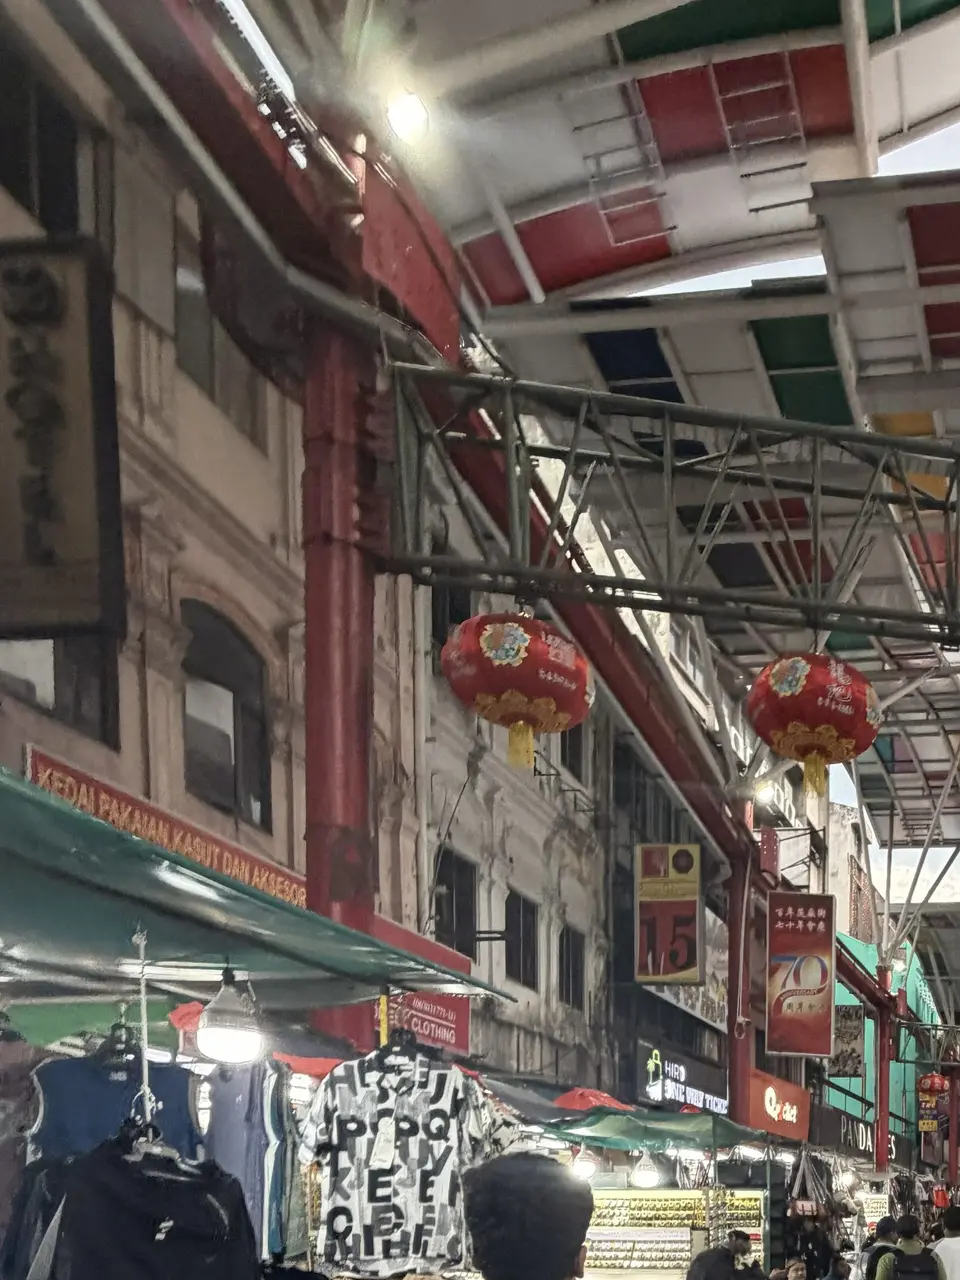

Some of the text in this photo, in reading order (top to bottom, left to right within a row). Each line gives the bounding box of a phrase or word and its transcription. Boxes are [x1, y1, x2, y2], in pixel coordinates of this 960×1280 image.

[173, 828, 219, 870] KASUT
[222, 853, 250, 884] DAN
[639, 914, 697, 975] 15
[771, 955, 829, 991] 70
[411, 1017, 456, 1044] CLOTHING
[664, 1060, 686, 1082] HIRO
[664, 1079, 685, 1103] ONE
[841, 1114, 873, 1152] PANDA
